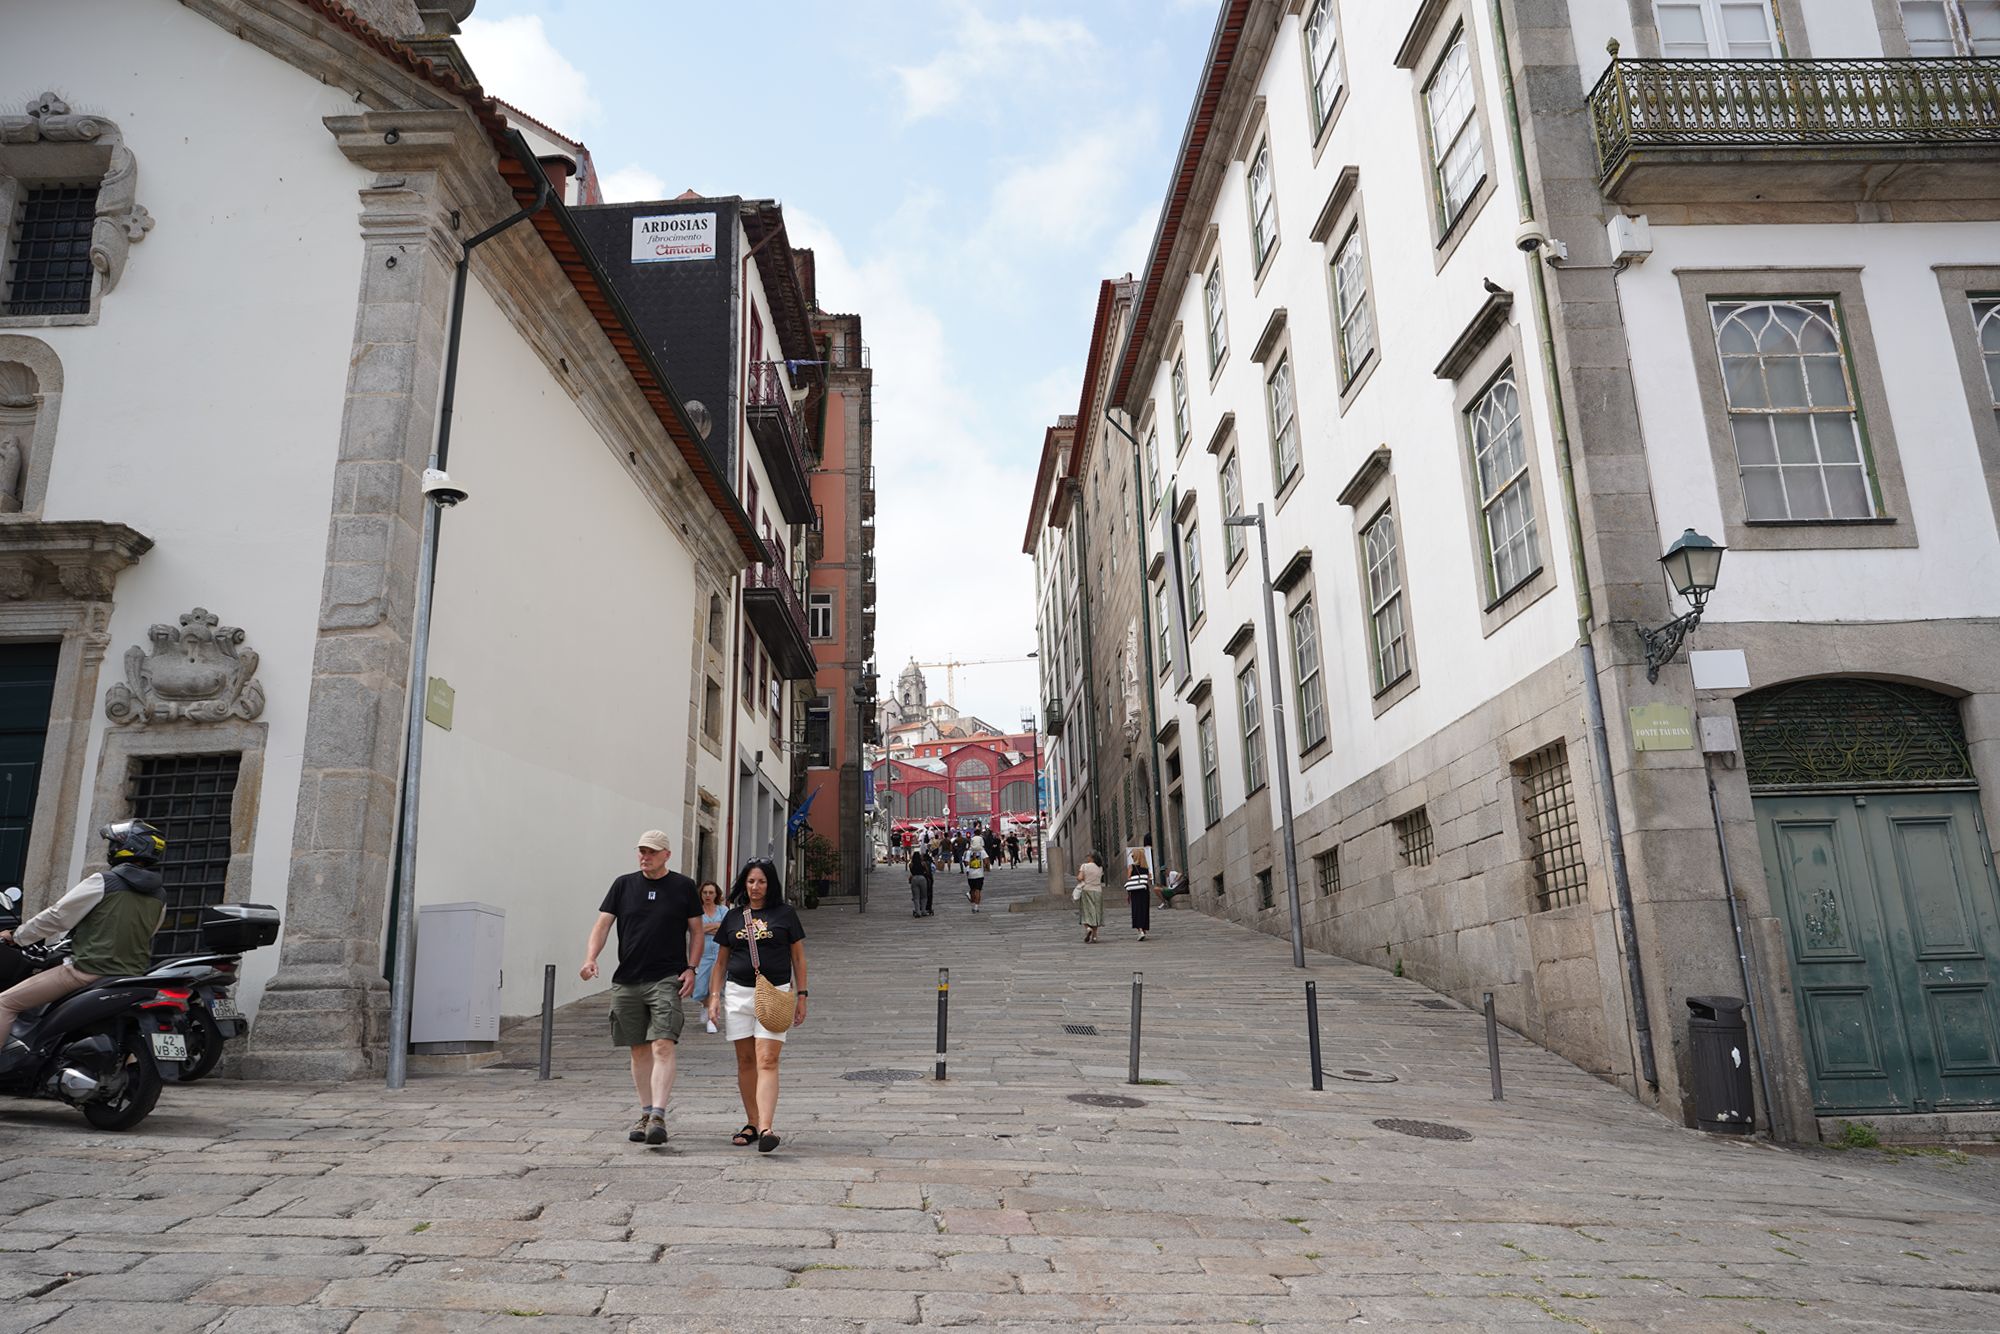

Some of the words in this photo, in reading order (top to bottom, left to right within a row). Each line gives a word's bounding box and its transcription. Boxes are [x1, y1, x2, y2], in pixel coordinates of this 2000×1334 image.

[641, 218, 708, 233] ARDOSIAS
[647, 234, 702, 245] fibrocimento
[163, 1035, 175, 1046] 42
